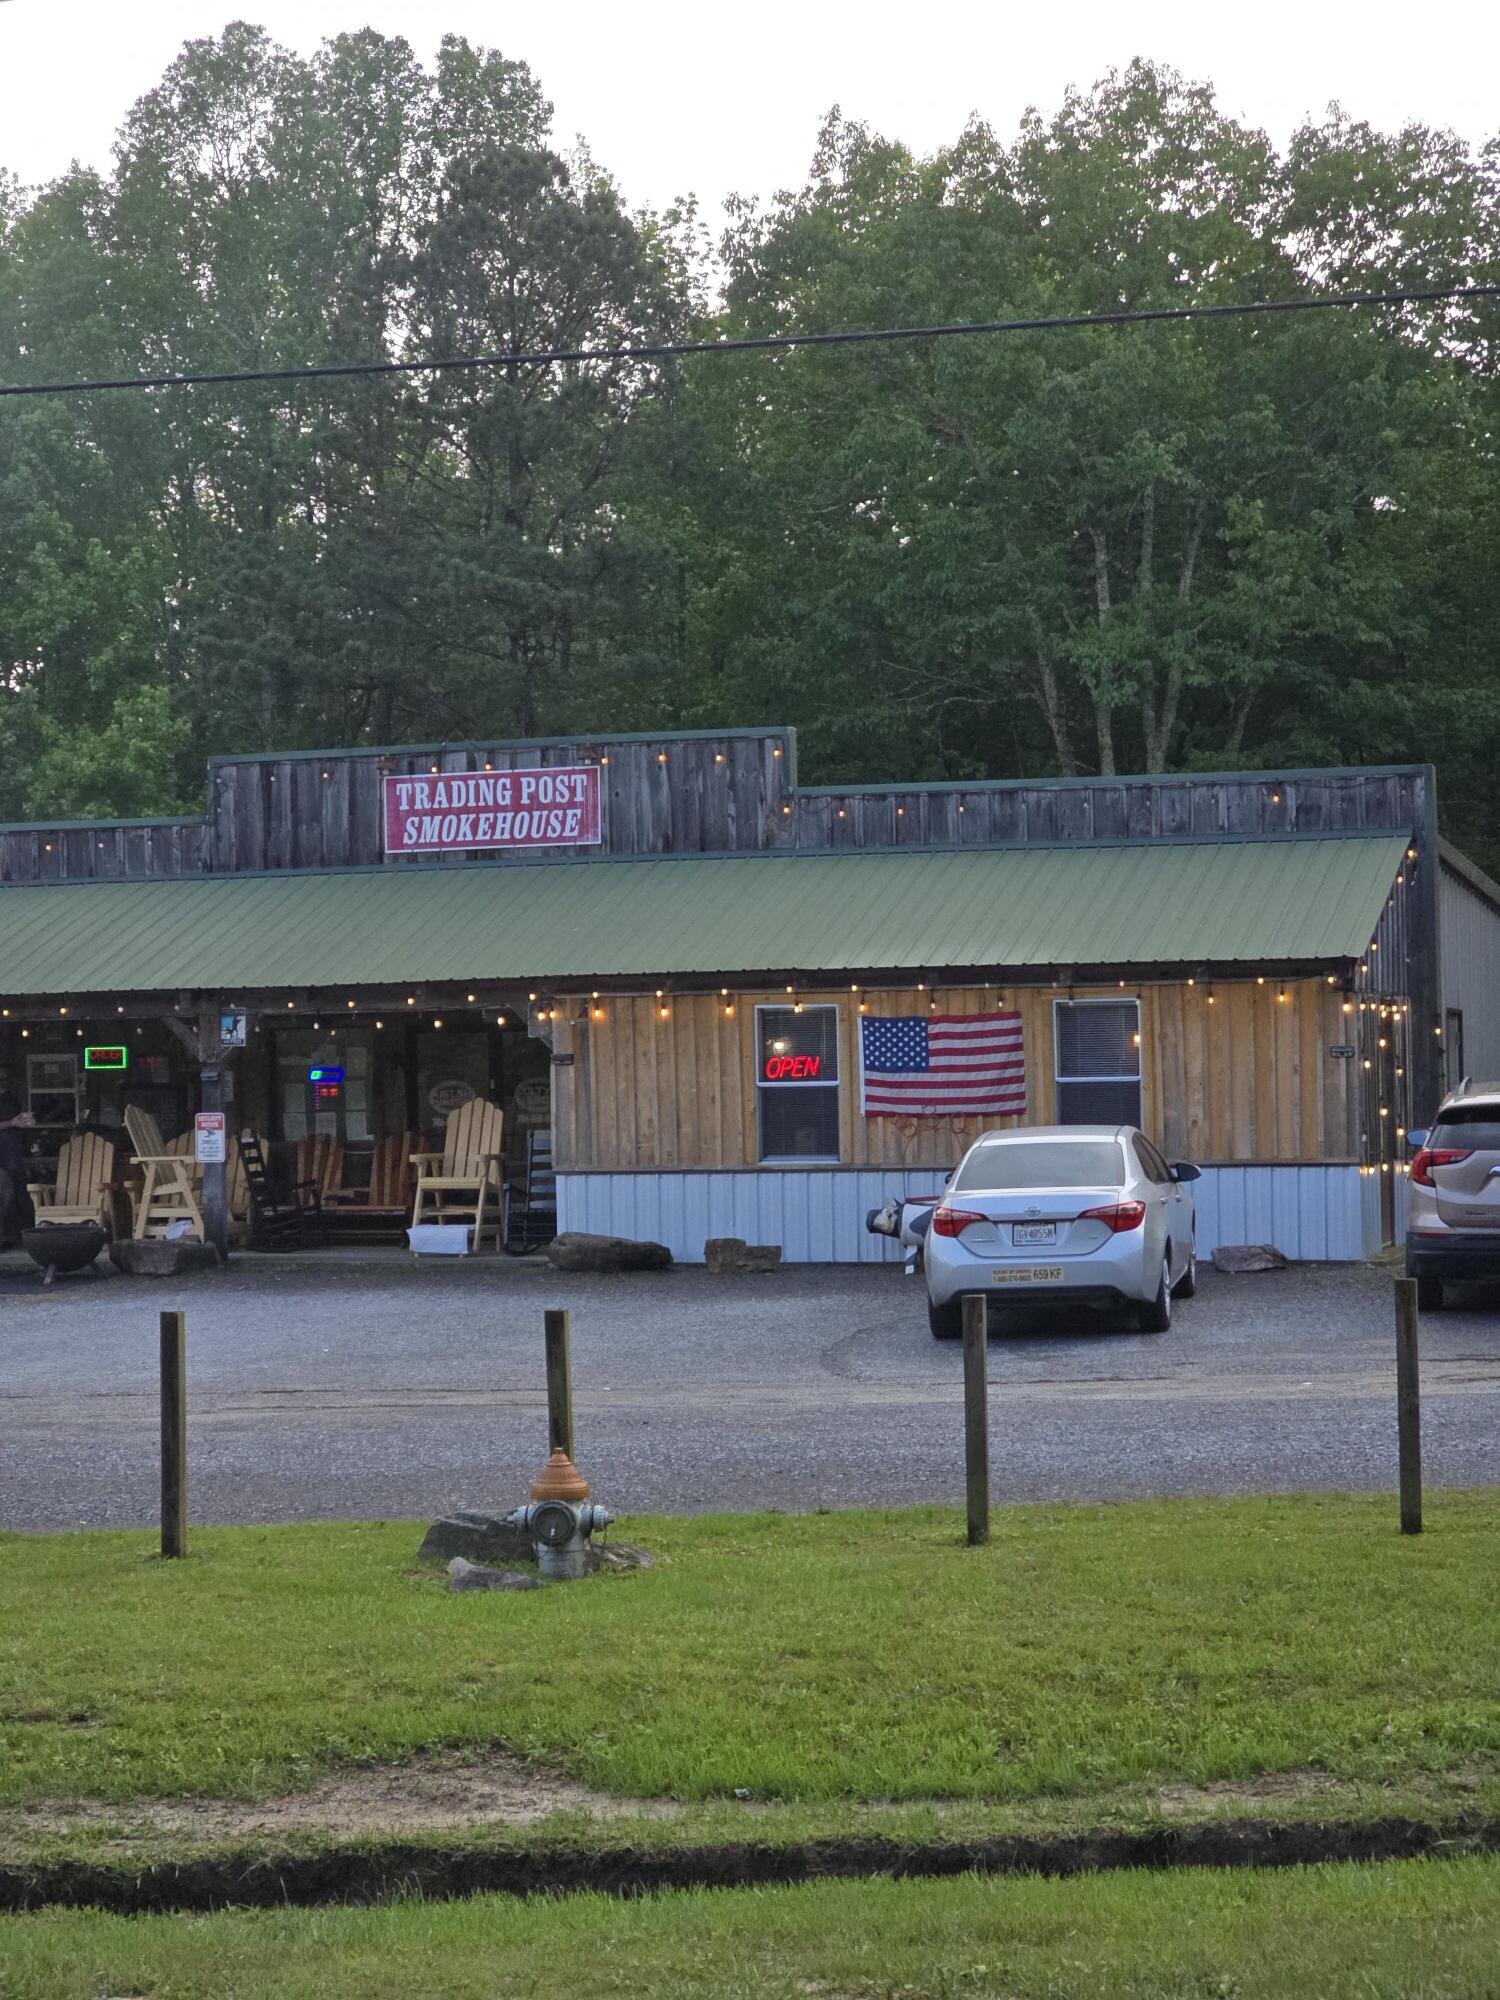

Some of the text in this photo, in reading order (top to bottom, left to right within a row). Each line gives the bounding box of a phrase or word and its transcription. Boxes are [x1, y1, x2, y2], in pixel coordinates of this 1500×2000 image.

[396, 774, 587, 811] TRADING POST
[403, 809, 582, 845] SMOKEHOUSE
[766, 1056, 820, 1079] OPEN
[1033, 1268, 1062, 1280] 659 KF
